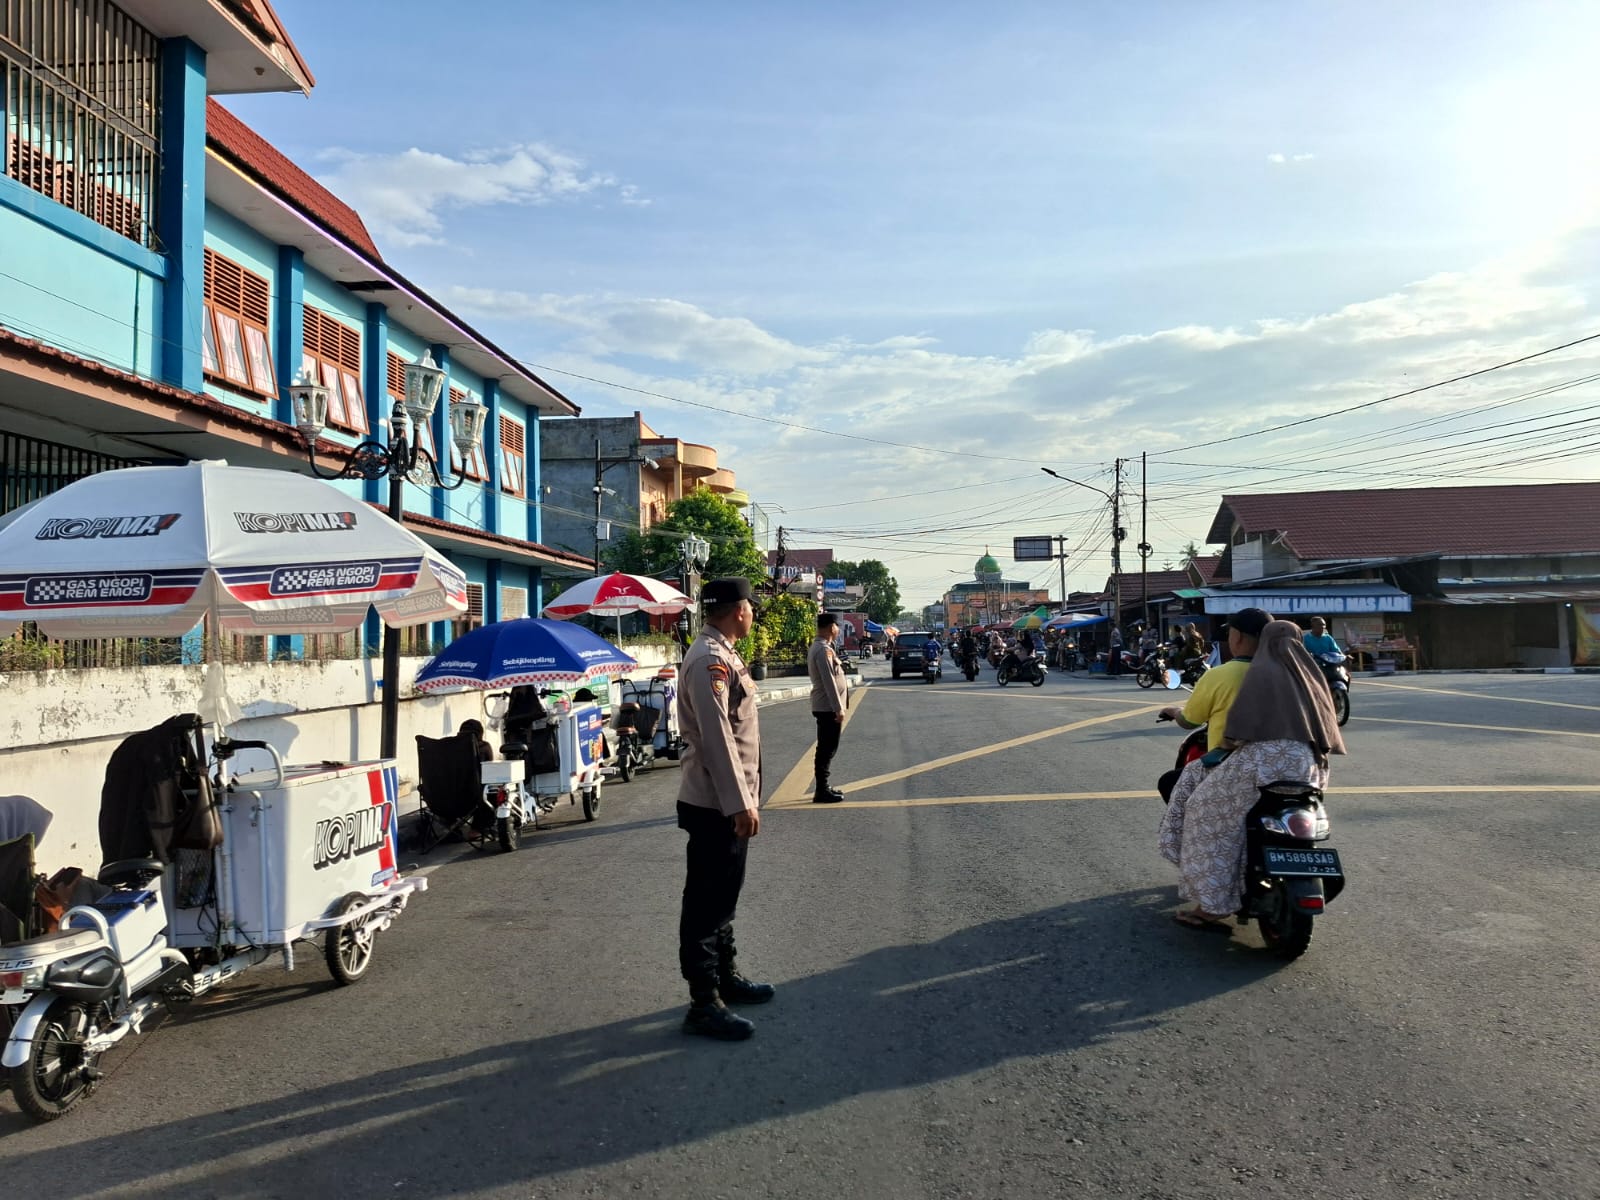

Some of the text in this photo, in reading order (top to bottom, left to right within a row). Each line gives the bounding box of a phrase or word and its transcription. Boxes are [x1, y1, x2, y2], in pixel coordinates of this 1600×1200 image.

[308, 567, 374, 579] GAS NGOPI
[67, 578, 144, 589] GAS NGOPI
[307, 575, 375, 587] REM EMOSI
[66, 587, 145, 599] REM EMOSI
